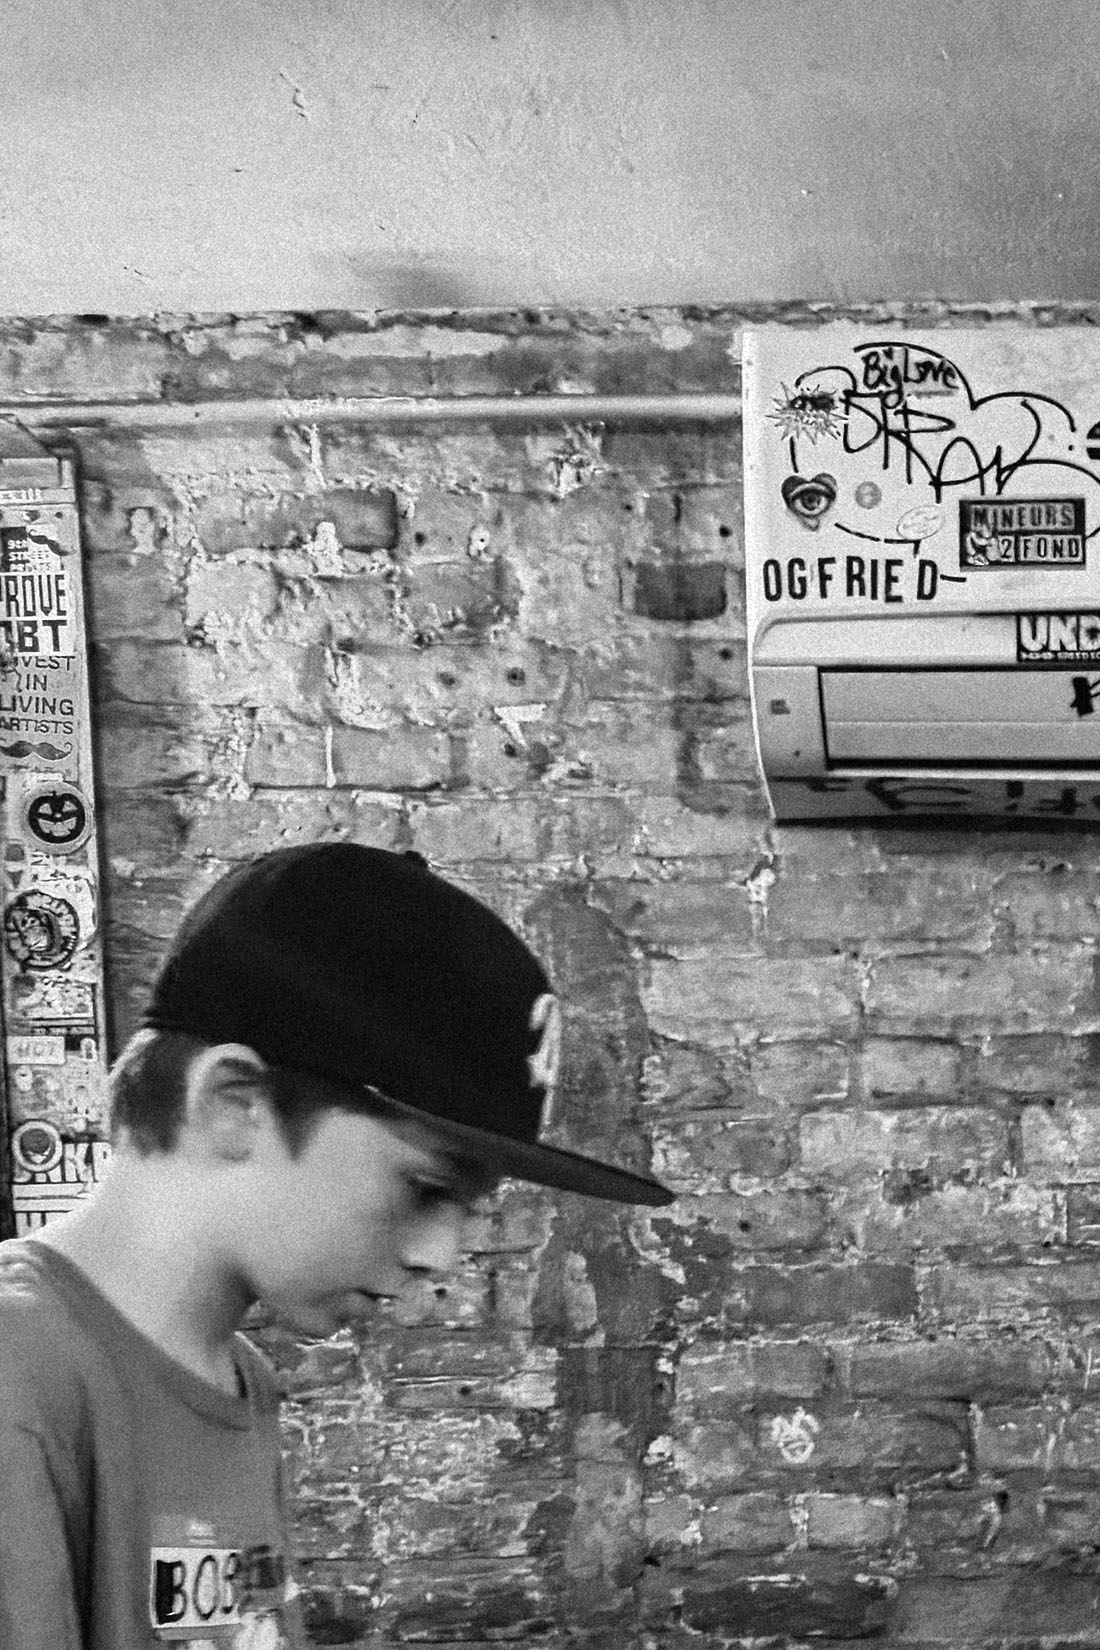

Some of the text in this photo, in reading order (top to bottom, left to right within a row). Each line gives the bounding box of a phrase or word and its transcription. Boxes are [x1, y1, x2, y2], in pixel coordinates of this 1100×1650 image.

[1022, 536, 1080, 560] FOND
[0, 575, 67, 617] ROVE
[26, 674, 48, 692] IN
